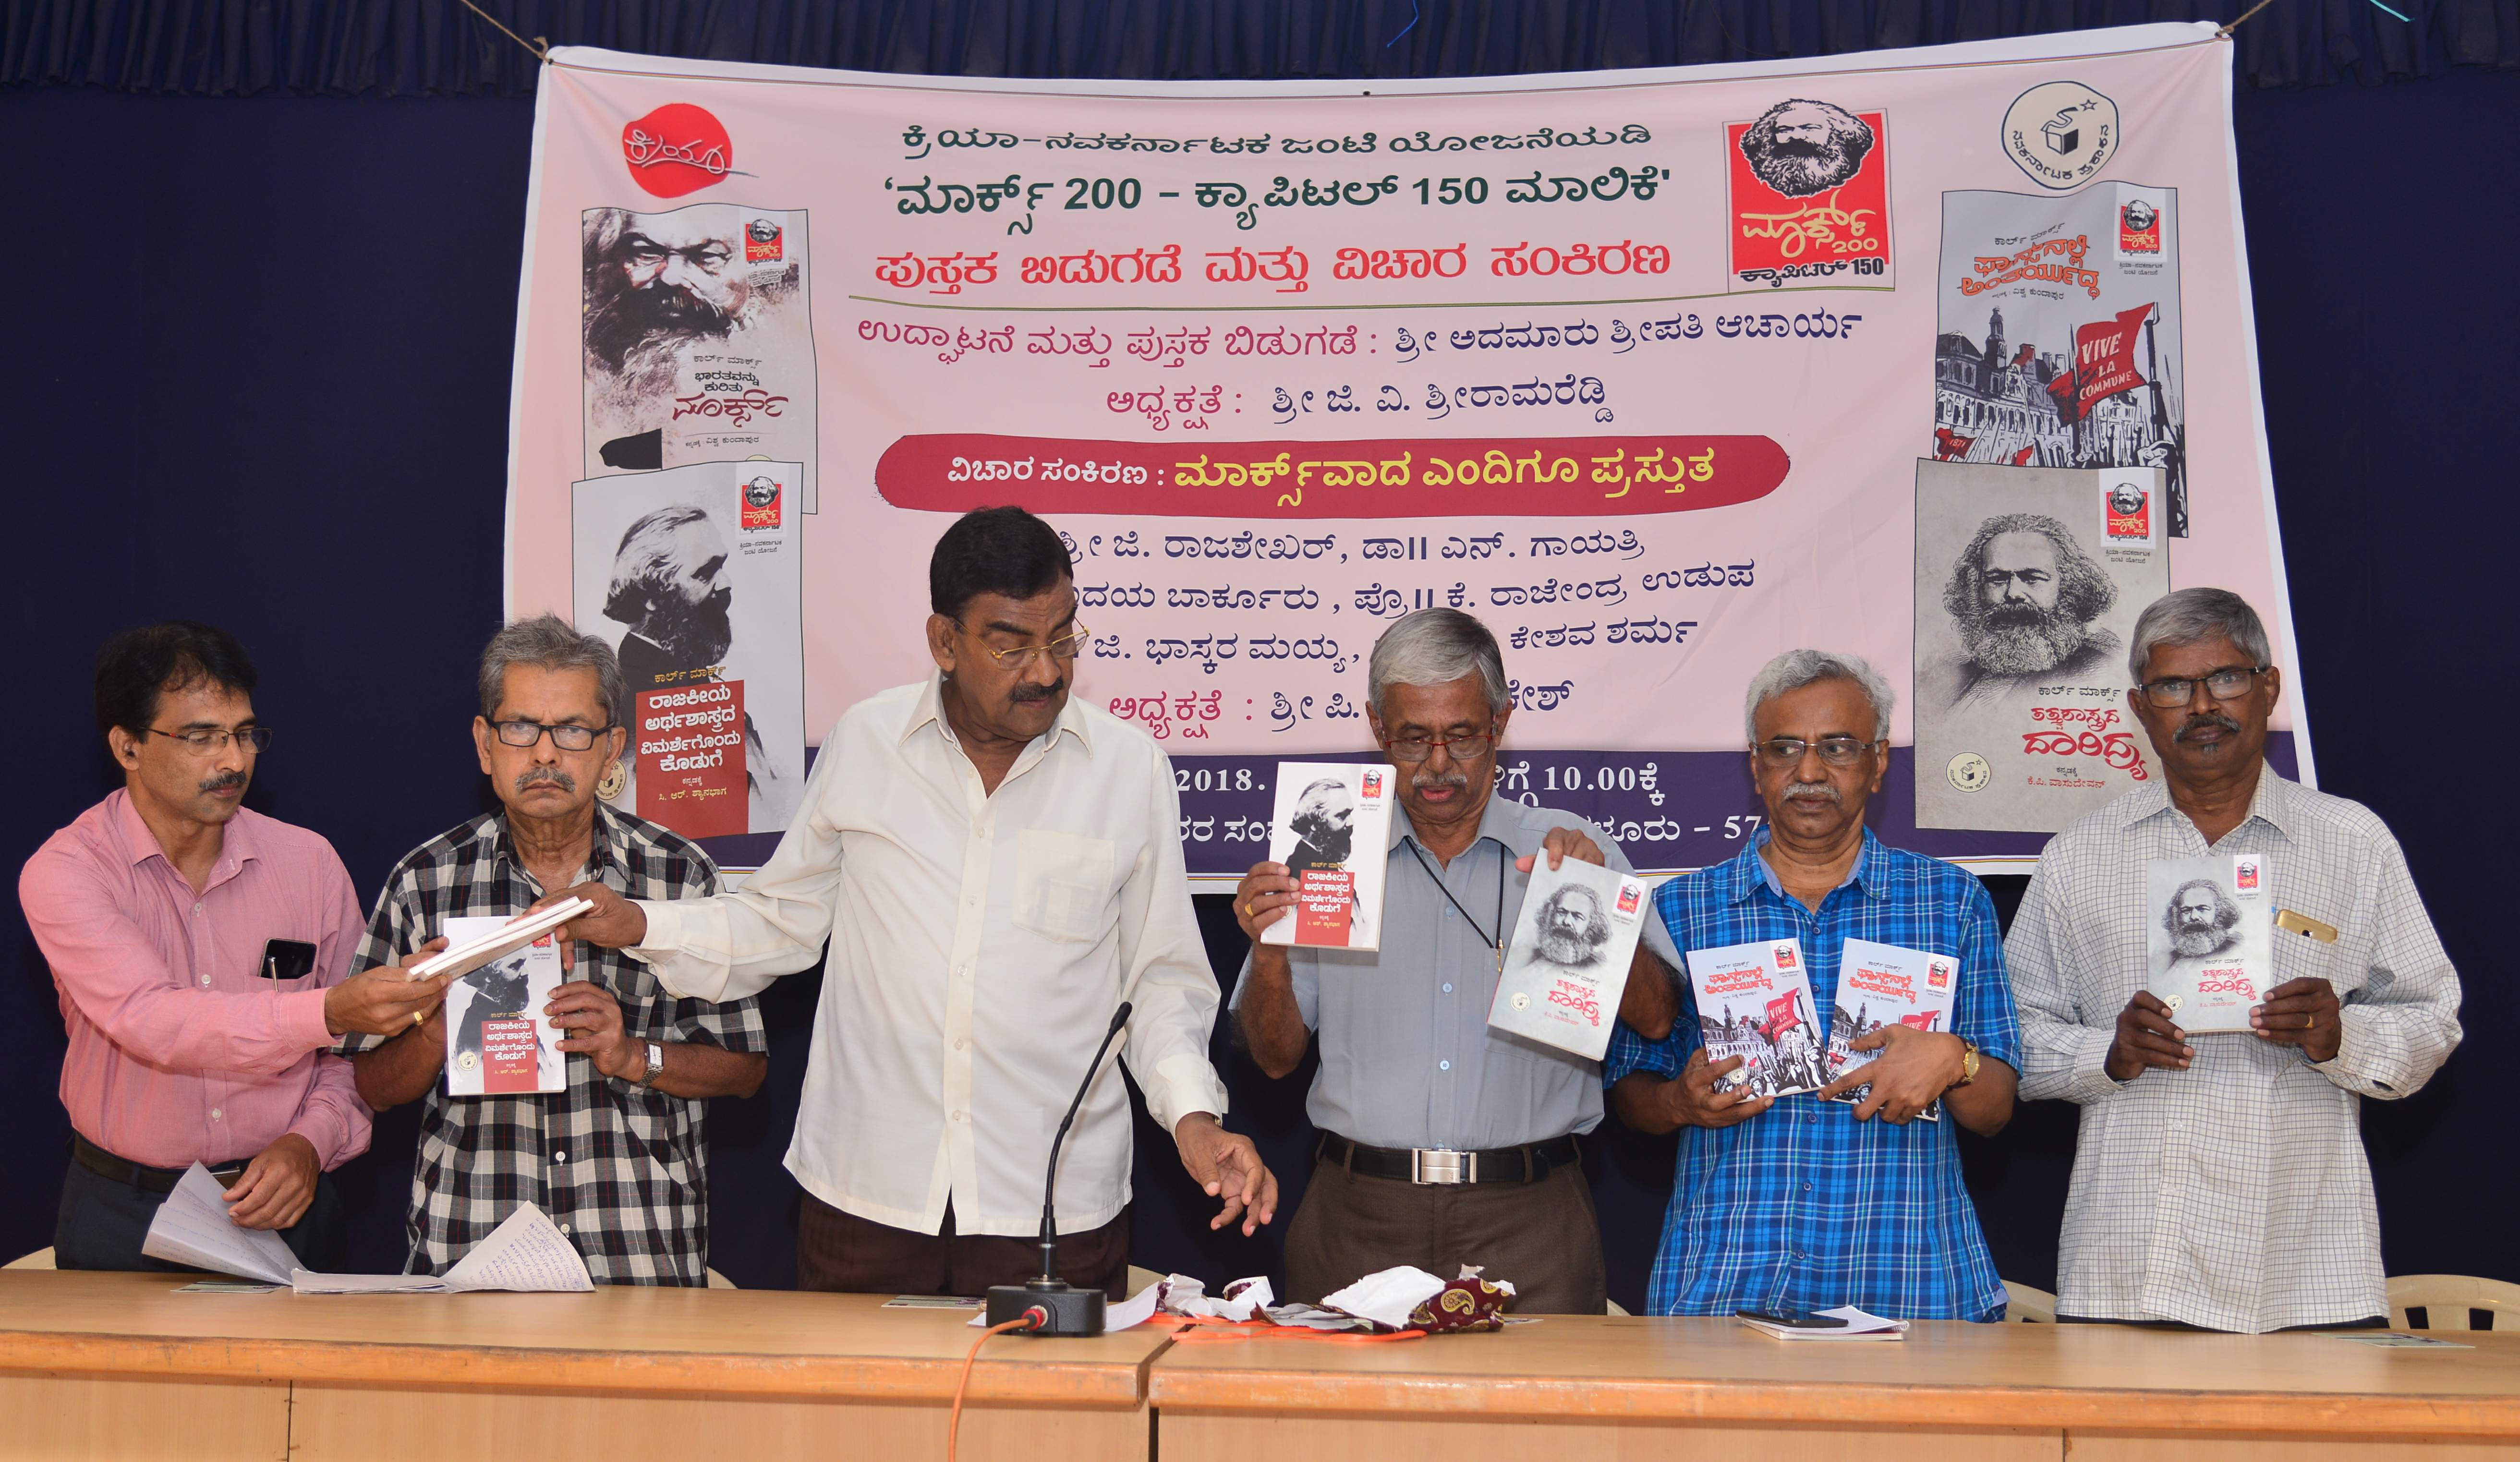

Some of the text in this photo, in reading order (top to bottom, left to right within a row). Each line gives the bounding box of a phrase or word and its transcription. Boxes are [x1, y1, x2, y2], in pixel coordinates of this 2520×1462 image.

[902, 124, 1651, 159] ಕ್ರಿಯಾ-ನವಕರ್ನಾಟಕ ಜಂಟಿ ಯೋಜನೆಯಡಿ
[1064, 178, 1141, 210] 200
[1195, 175, 1398, 230] ಕ್ಯಾಪಿಟಲ್
[1412, 178, 1488, 205] 150
[1832, 238, 1878, 253] 200
[875, 240, 1670, 294] ಪುಸ್ತಕ ಬಿಡುಗಡೆ ಮತ್ತು ವಿಚಾರ ಸಂಕಿರಣ
[1740, 258, 1884, 287] ಕ್ಯಾಪಿಟಲ್ 150
[859, 320, 1014, 365] ಉದ್ಘಾಟನೆ
[1027, 325, 1112, 367] ಮತ್ತು
[1127, 325, 1210, 367] ಪುಸ್ತಕ
[1224, 324, 1357, 356] ಬಿಡುಗಡೆ
[1395, 325, 1435, 363] ಶ್ರೀ
[1450, 319, 1599, 351] ಅದಮಾರು
[1611, 312, 1703, 354] ಶ್ರೀಪತಿ
[1716, 306, 1862, 338] ಆಚಾರ್ಯ
[2082, 332, 2122, 364] VIVE
[727, 357, 762, 369] ಮಾರ್ಕ್ಸ್
[2098, 361, 2116, 377] LA
[695, 371, 759, 386] ಭಾರತವನ್ನು
[705, 382, 742, 392] ಕುರಿತು
[2079, 370, 2132, 400] COMMUNE
[1107, 386, 1222, 431] ಅಧ್ಯಕ್ಷತೆ
[1272, 387, 1313, 424] ಶ್ರೀ
[1327, 384, 1360, 412] ಜಿ.
[1376, 385, 1409, 412] ವಿ.
[1425, 374, 1614, 422] ಶ್ರೀರಾಮರೆಡ್ಡಿ
[1950, 439, 1966, 447] 1871
[947, 456, 1034, 482] ವಿಚಾರ
[1041, 457, 1147, 484] ಸಂಕಿರಣ
[1423, 450, 1578, 486] ಎಂದಿಗೂ
[1591, 447, 1714, 498] ಪ್ರಸ್ತುತ
[1114, 531, 1150, 558] ಜಿ.
[1165, 531, 1347, 564] ರಾಜಶೇಖರ್,
[1442, 532, 1515, 560] ಎನ್.
[1531, 530, 1644, 560] ಗಾಯತ್ರಿ
[1168, 584, 1319, 609] ಬಾರ್ಕೂರು
[1447, 582, 1475, 607] ಕೆ.
[1490, 574, 1627, 606] ರಾಜೇಂದ್ರ
[1642, 559, 1755, 591] ಉಡುಪ
[1094, 635, 1130, 659] ಜಿ.
[1146, 633, 1238, 674] ಭಾಸ್ಕರ
[1249, 633, 1359, 673] ಮಯ್ಯ,
[1510, 621, 1595, 649] ಕೇಶವ
[1607, 615, 1698, 644] ಶರ್ಮ
[655, 671, 686, 682] ಕಾರ್ಲ್
[649, 684, 731, 709] ರಾಜಕೀಯ
[2038, 686, 2120, 702] ಕಾರ್ಲ್ ಮಾರ್ಕ್ಸ್
[645, 704, 735, 732] ಅರ್ಥಶಾಸ್ತ್ರದ
[1110, 689, 1222, 739] ಅಧ್ಯಕ್ಷತೆ
[1271, 691, 1313, 732] ಶ್ರೀ
[1325, 694, 1359, 718] ಪಿ.
[641, 730, 740, 754] ವಿಮರ್ಶೆಗೊಂದು
[660, 749, 723, 772] ಕೊಡುಗೆ
[2057, 767, 2077, 777] ಕನ್ನಡಕ್ಕೆ
[682, 776, 702, 786] ಕನ್ನಡಕ್ಕೆ
[1543, 762, 1665, 806] 10.00ಕ್ಕೆ
[2049, 778, 2105, 788] ವಾಸುದೇವನ್
[1770, 1002, 1787, 1018] VIVE
[1779, 1015, 1787, 1023] LA
[488, 1020, 530, 1030] ರಾಜಕೀಯ
[1772, 1017, 1795, 1034] COMMUNE
[495, 1051, 526, 1060] ಕೊಡುಗೆ
